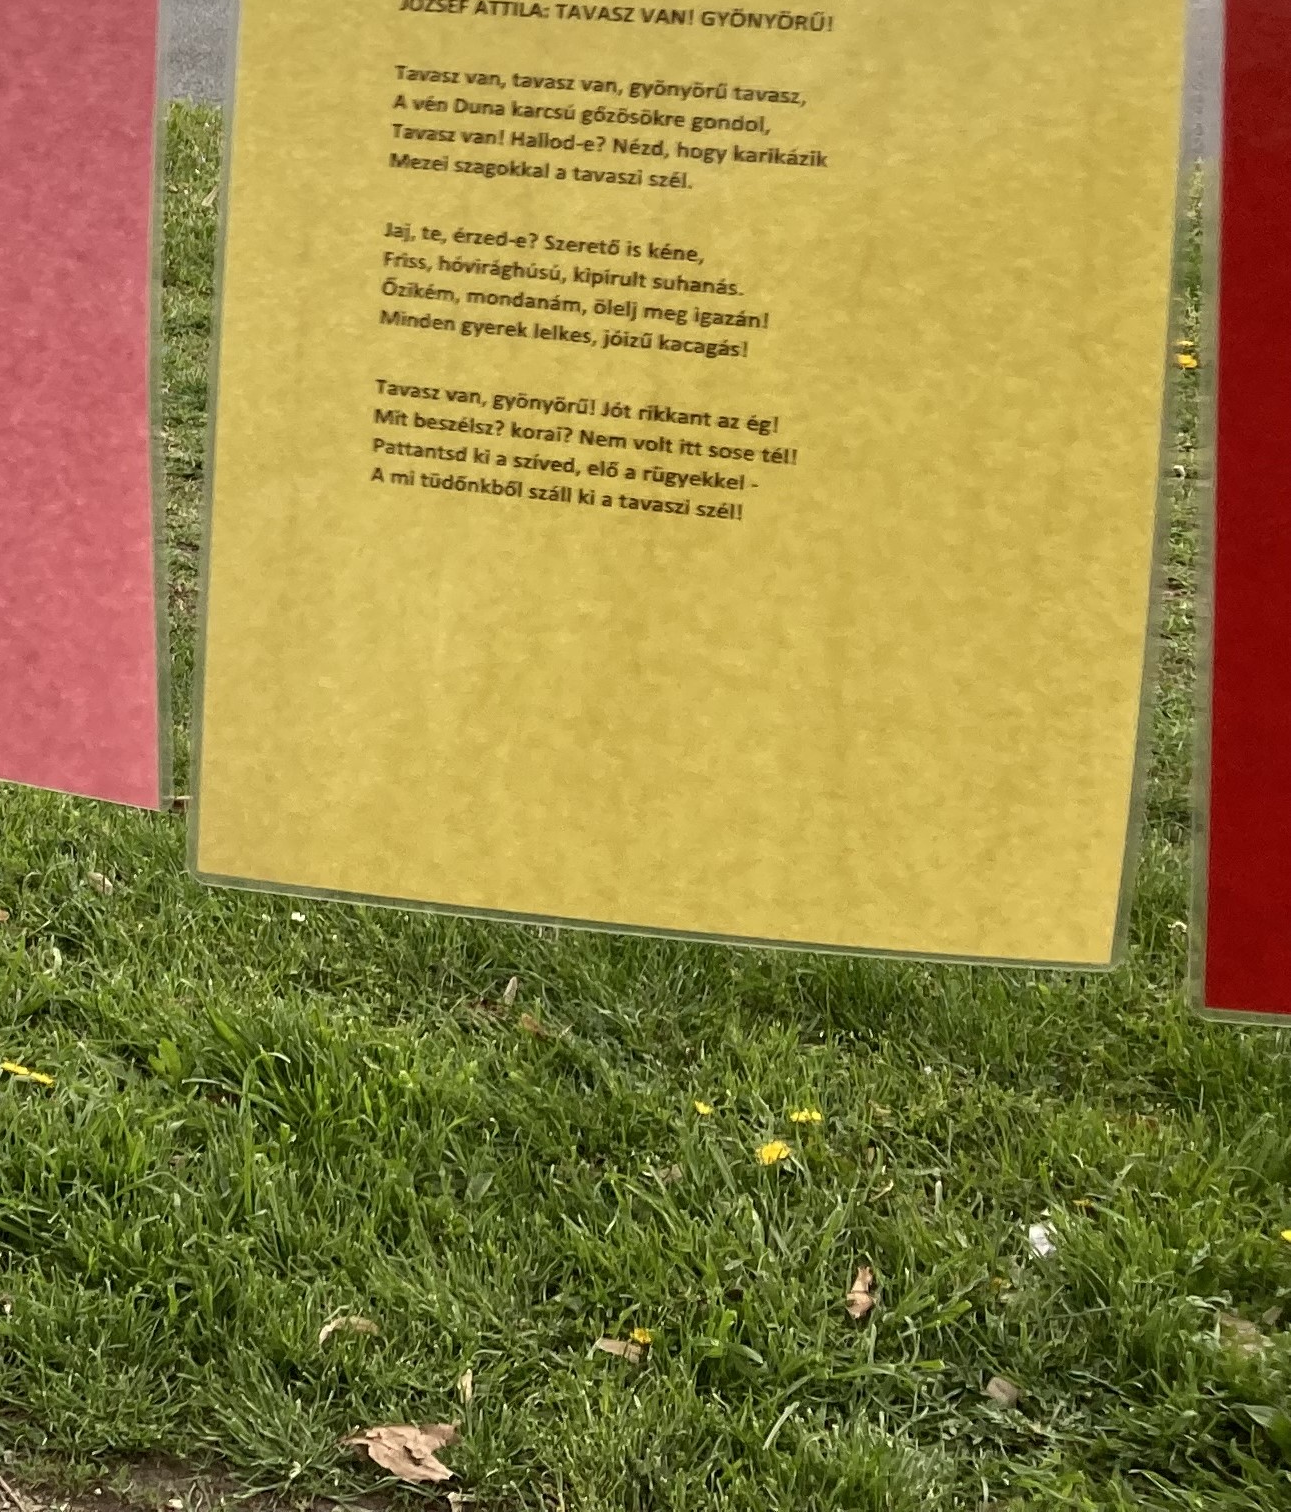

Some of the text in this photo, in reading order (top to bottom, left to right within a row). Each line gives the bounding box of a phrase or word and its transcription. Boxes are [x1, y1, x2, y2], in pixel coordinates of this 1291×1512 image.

[471, 0, 551, 19] ATTILA:
[554, 3, 636, 23] TAVASZ
[639, 7, 695, 26] VAN!
[393, 64, 807, 108] Tavasz van, tavasz van, gyönyörű tavasz,
[391, 93, 771, 136] A vén Duna karcsú gőzösökre gondol,
[391, 123, 829, 169] Tavasz van! Hallod-e? Nézd, hogy karikázik
[452, 159, 550, 179] szagokkal
[554, 167, 568, 181] a
[571, 166, 644, 187] tavaszi
[647, 171, 693, 190] szél.
[420, 225, 448, 245] te,
[451, 226, 540, 250] érzed-e?
[542, 234, 621, 256] Szerető
[624, 240, 642, 258] is
[646, 241, 705, 267] kéne,
[381, 250, 433, 274] Friss,
[650, 273, 745, 297] suhanás.
[465, 290, 588, 317] mondanám,
[592, 298, 639, 323] ölelj
[640, 306, 689, 327] meg
[691, 306, 770, 330] igazán!
[379, 309, 457, 332] Minden
[458, 320, 529, 338] gyerek
[531, 322, 598, 348] lelkes,
[656, 333, 749, 360] kacagás!
[374, 378, 441, 401] Tavasz
[444, 389, 488, 408] van,
[599, 400, 633, 420] Jót
[637, 404, 713, 428] rikkant
[713, 415, 741, 430] az
[745, 413, 780, 437] ég!
[373, 408, 798, 466] Mit beszélsz? korai? Nem volt itt sose tél!
[371, 437, 469, 463] Pattantsd
[472, 447, 491, 465] ki
[494, 453, 508, 467] a
[586, 459, 620, 479] elő
[622, 467, 637, 480] a
[641, 465, 745, 491] rügyekkel
[370, 466, 743, 522] A mi tüdőnkből száll ki a tavaszi szél!
